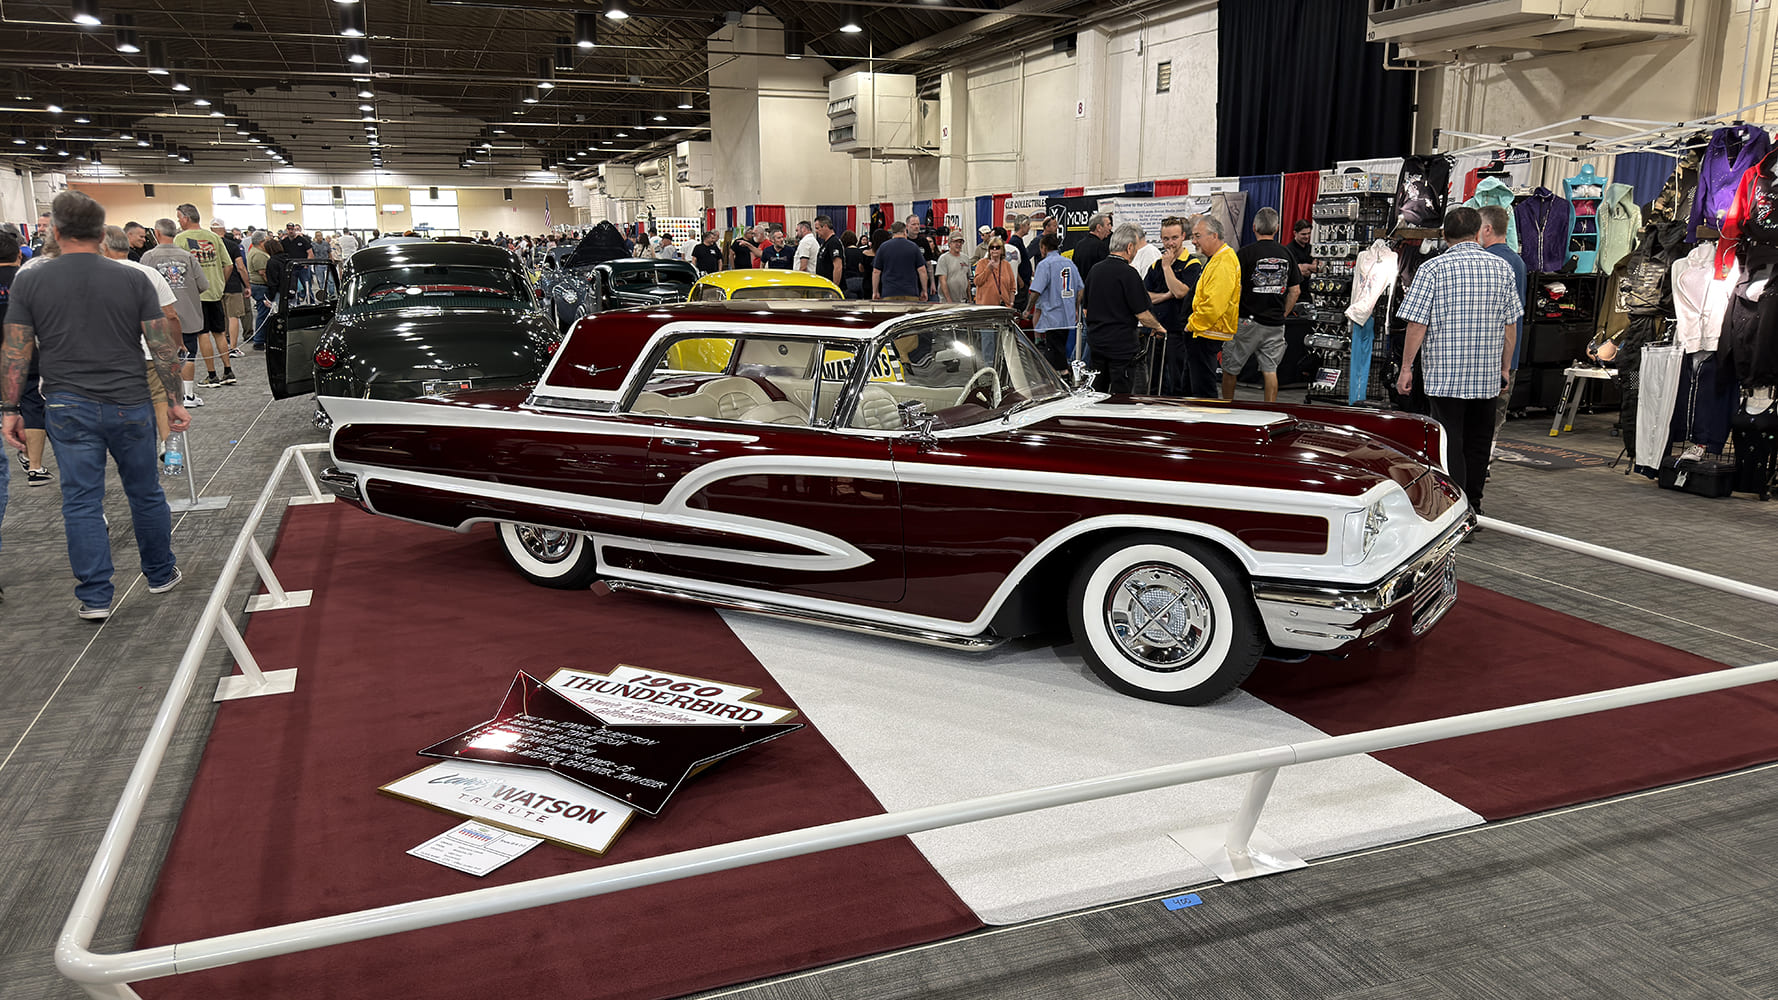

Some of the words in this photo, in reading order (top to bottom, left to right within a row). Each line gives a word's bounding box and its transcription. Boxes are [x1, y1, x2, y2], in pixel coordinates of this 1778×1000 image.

[1077, 102, 1083, 114] 8
[561, 675, 763, 722] THUNDERBIRD
[628, 674, 724, 697] 1960
[458, 792, 550, 823] TRIBUTE
[492, 784, 608, 825] WATSON
